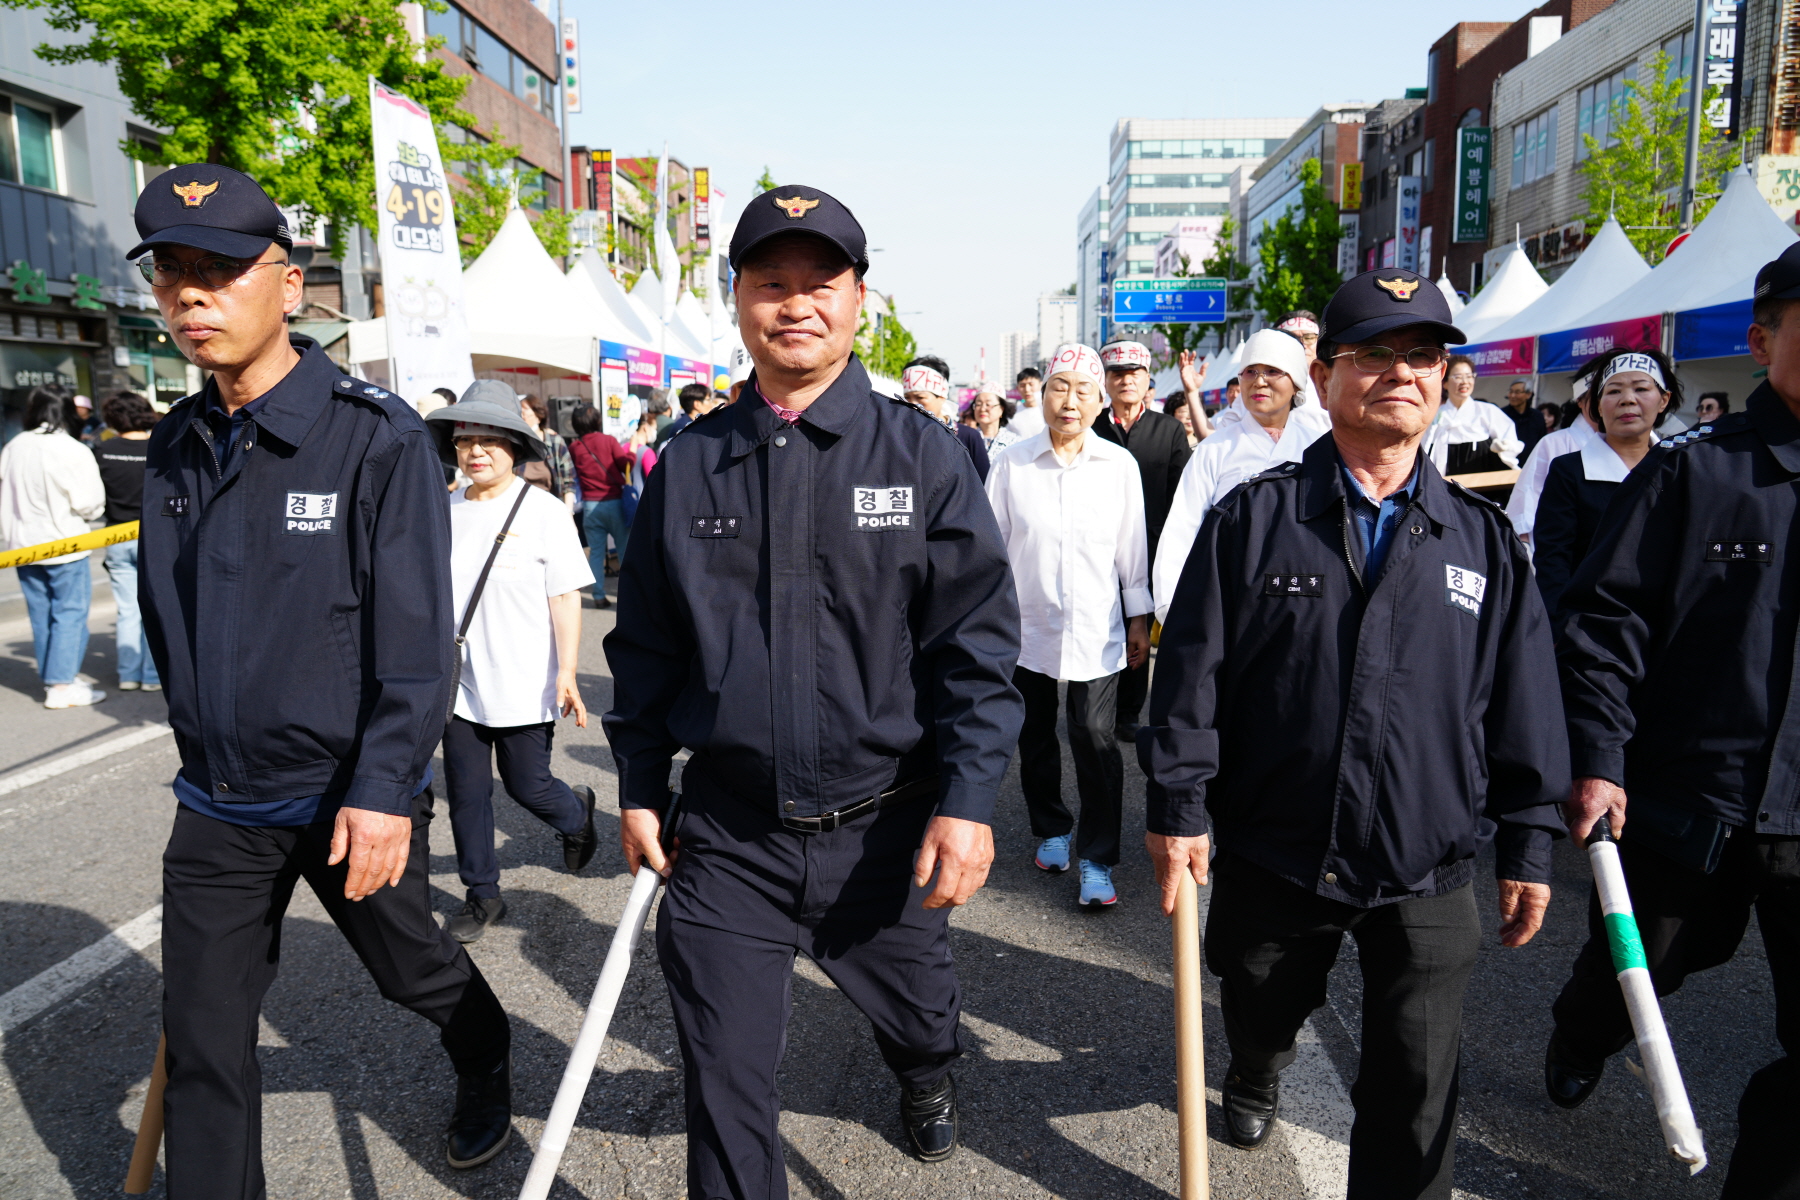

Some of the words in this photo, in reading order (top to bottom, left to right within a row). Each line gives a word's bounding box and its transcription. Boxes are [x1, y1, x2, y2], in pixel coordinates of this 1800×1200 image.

[1464, 132, 1488, 143] The
[1402, 186, 1419, 244] 아리랑
[393, 224, 443, 253] 대모험
[1154, 294, 1183, 305] 도봉로
[1600, 354, 1657, 387] 러가라
[290, 495, 333, 516] 경찰
[858, 490, 909, 511] 경찰
[287, 519, 332, 532] POLICE
[858, 515, 910, 527] POLICE
